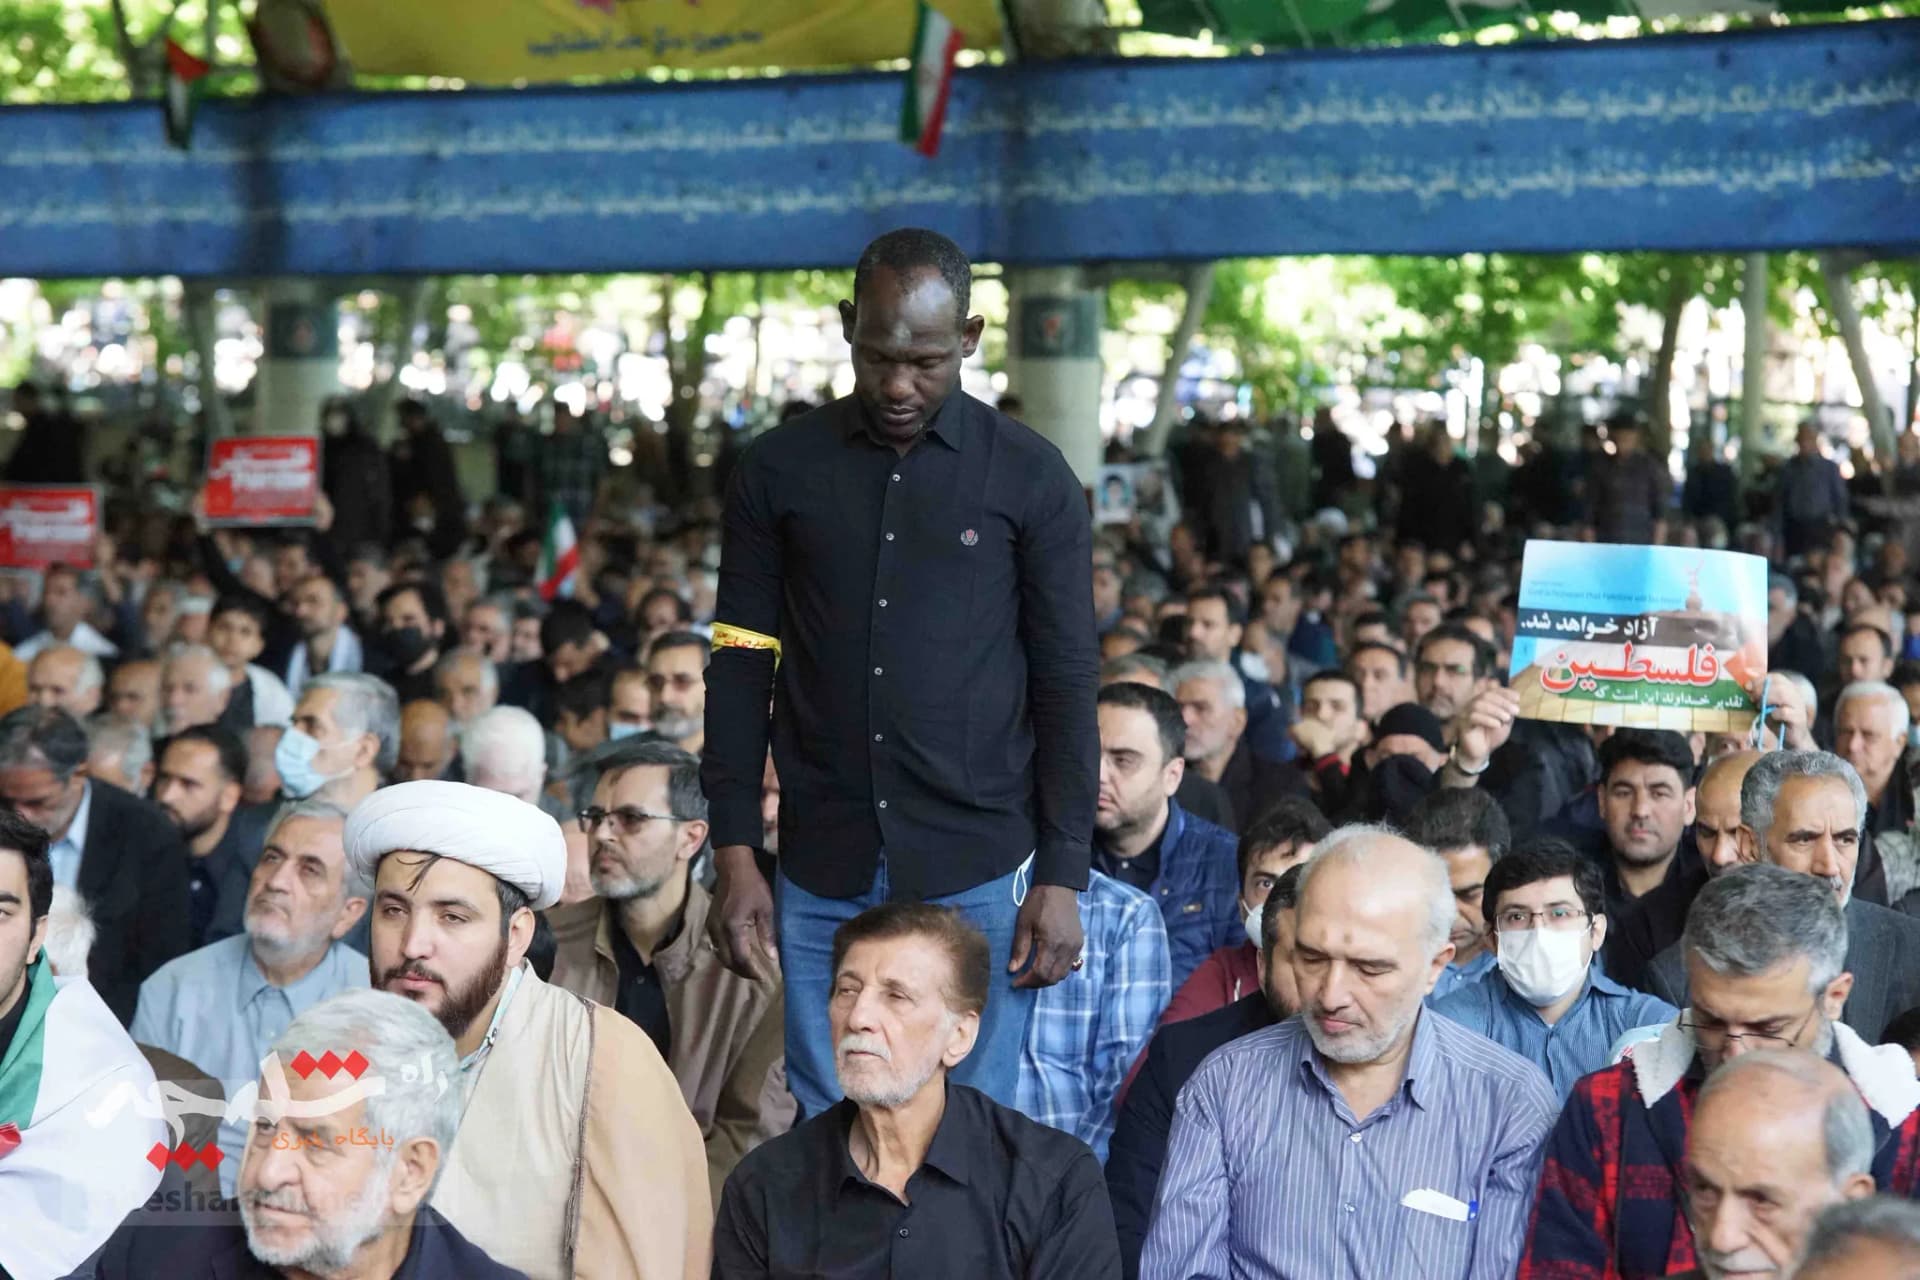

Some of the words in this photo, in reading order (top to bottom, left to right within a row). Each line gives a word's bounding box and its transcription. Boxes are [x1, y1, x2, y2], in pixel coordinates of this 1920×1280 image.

[1520, 612, 1552, 630] شد.
[1555, 615, 1620, 640] خواهد
[1623, 616, 1659, 641] آزاد
[1541, 641, 1719, 692] فلسطین
[1593, 684, 1611, 699] که
[1611, 688, 1638, 701] است
[1662, 691, 1710, 707] خداوند
[1714, 694, 1744, 710] تقدیر
